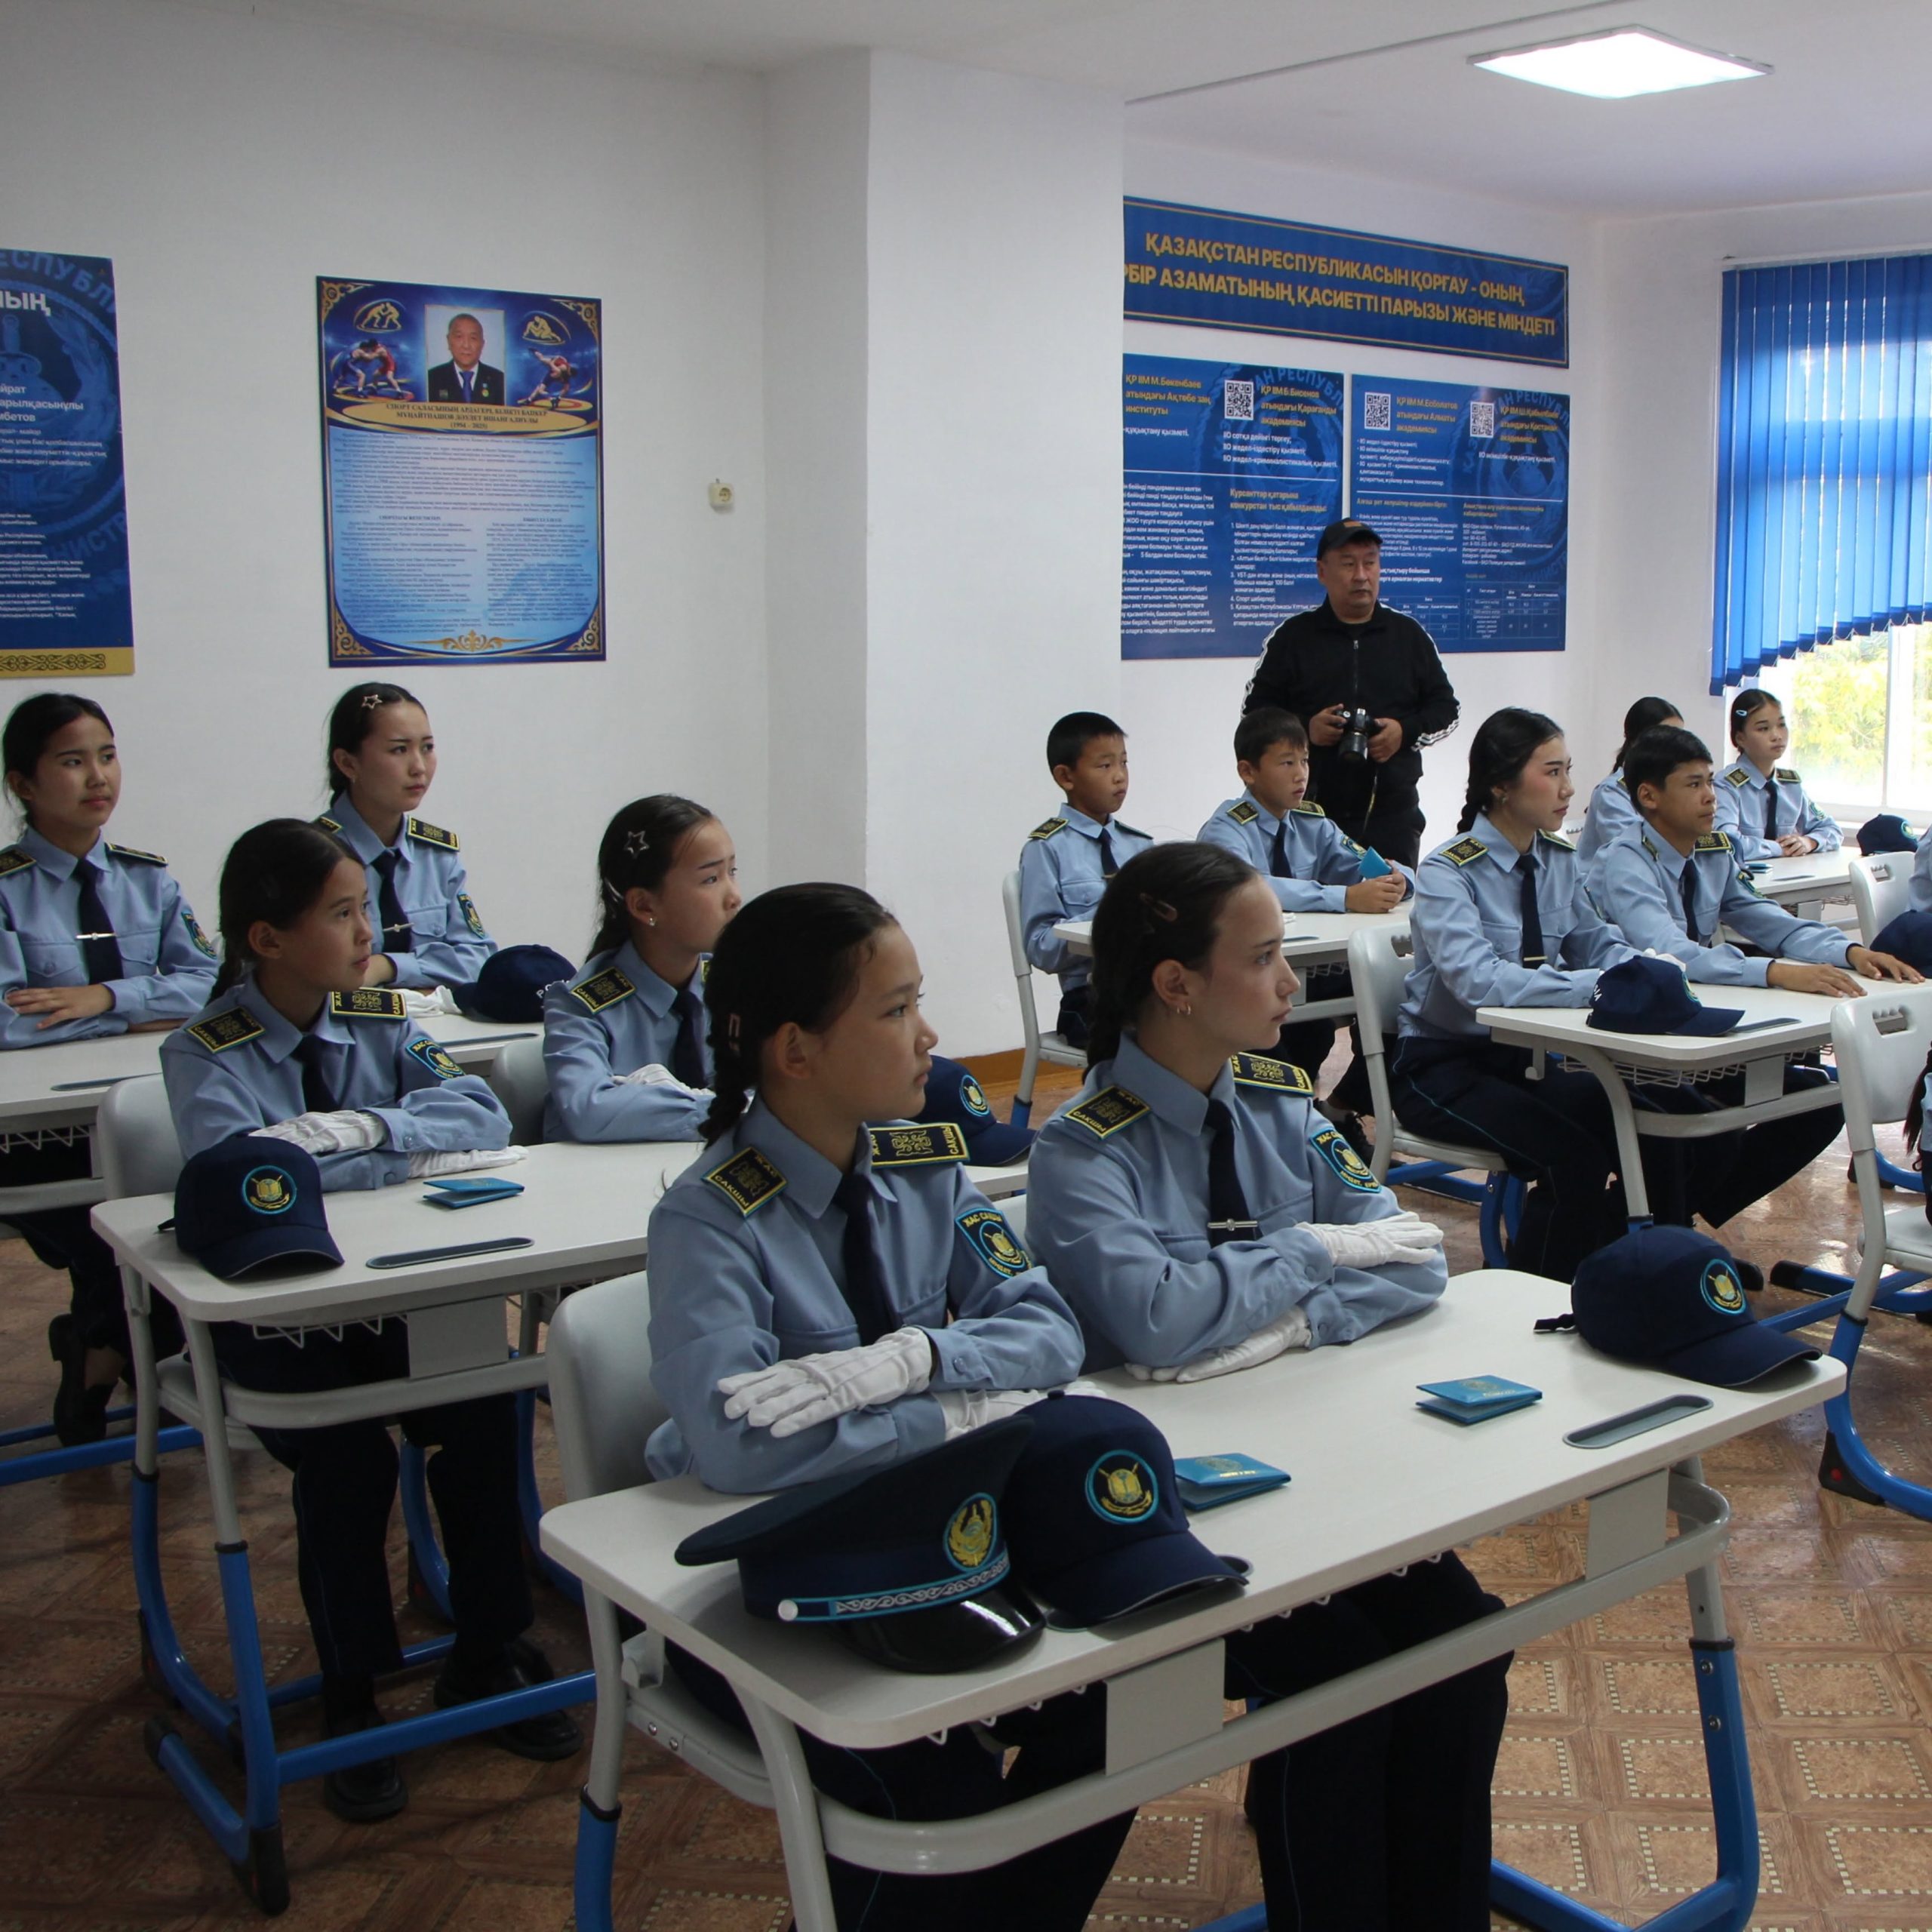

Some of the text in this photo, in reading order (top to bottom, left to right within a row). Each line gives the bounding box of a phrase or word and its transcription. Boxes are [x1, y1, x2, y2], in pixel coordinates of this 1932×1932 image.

[1145, 232, 1260, 266] ҚАЗАҚСТАН
[1262, 249, 1409, 287] РЕСПУБЛИКАСЫН
[1411, 270, 1469, 295] ҚОРҒАУ
[1478, 281, 1525, 306] ОНЫҢ
[1159, 267, 1295, 306] АЗАМАТЫНЫҢ
[1297, 285, 1379, 312] ҚАСИЕТТІ
[1381, 295, 1449, 322] ПАРЫЗЫ
[1451, 306, 1496, 328] ЖӘНЕ
[1498, 315, 1555, 337] МІНДЕТІ
[1126, 406, 1168, 415] институты
